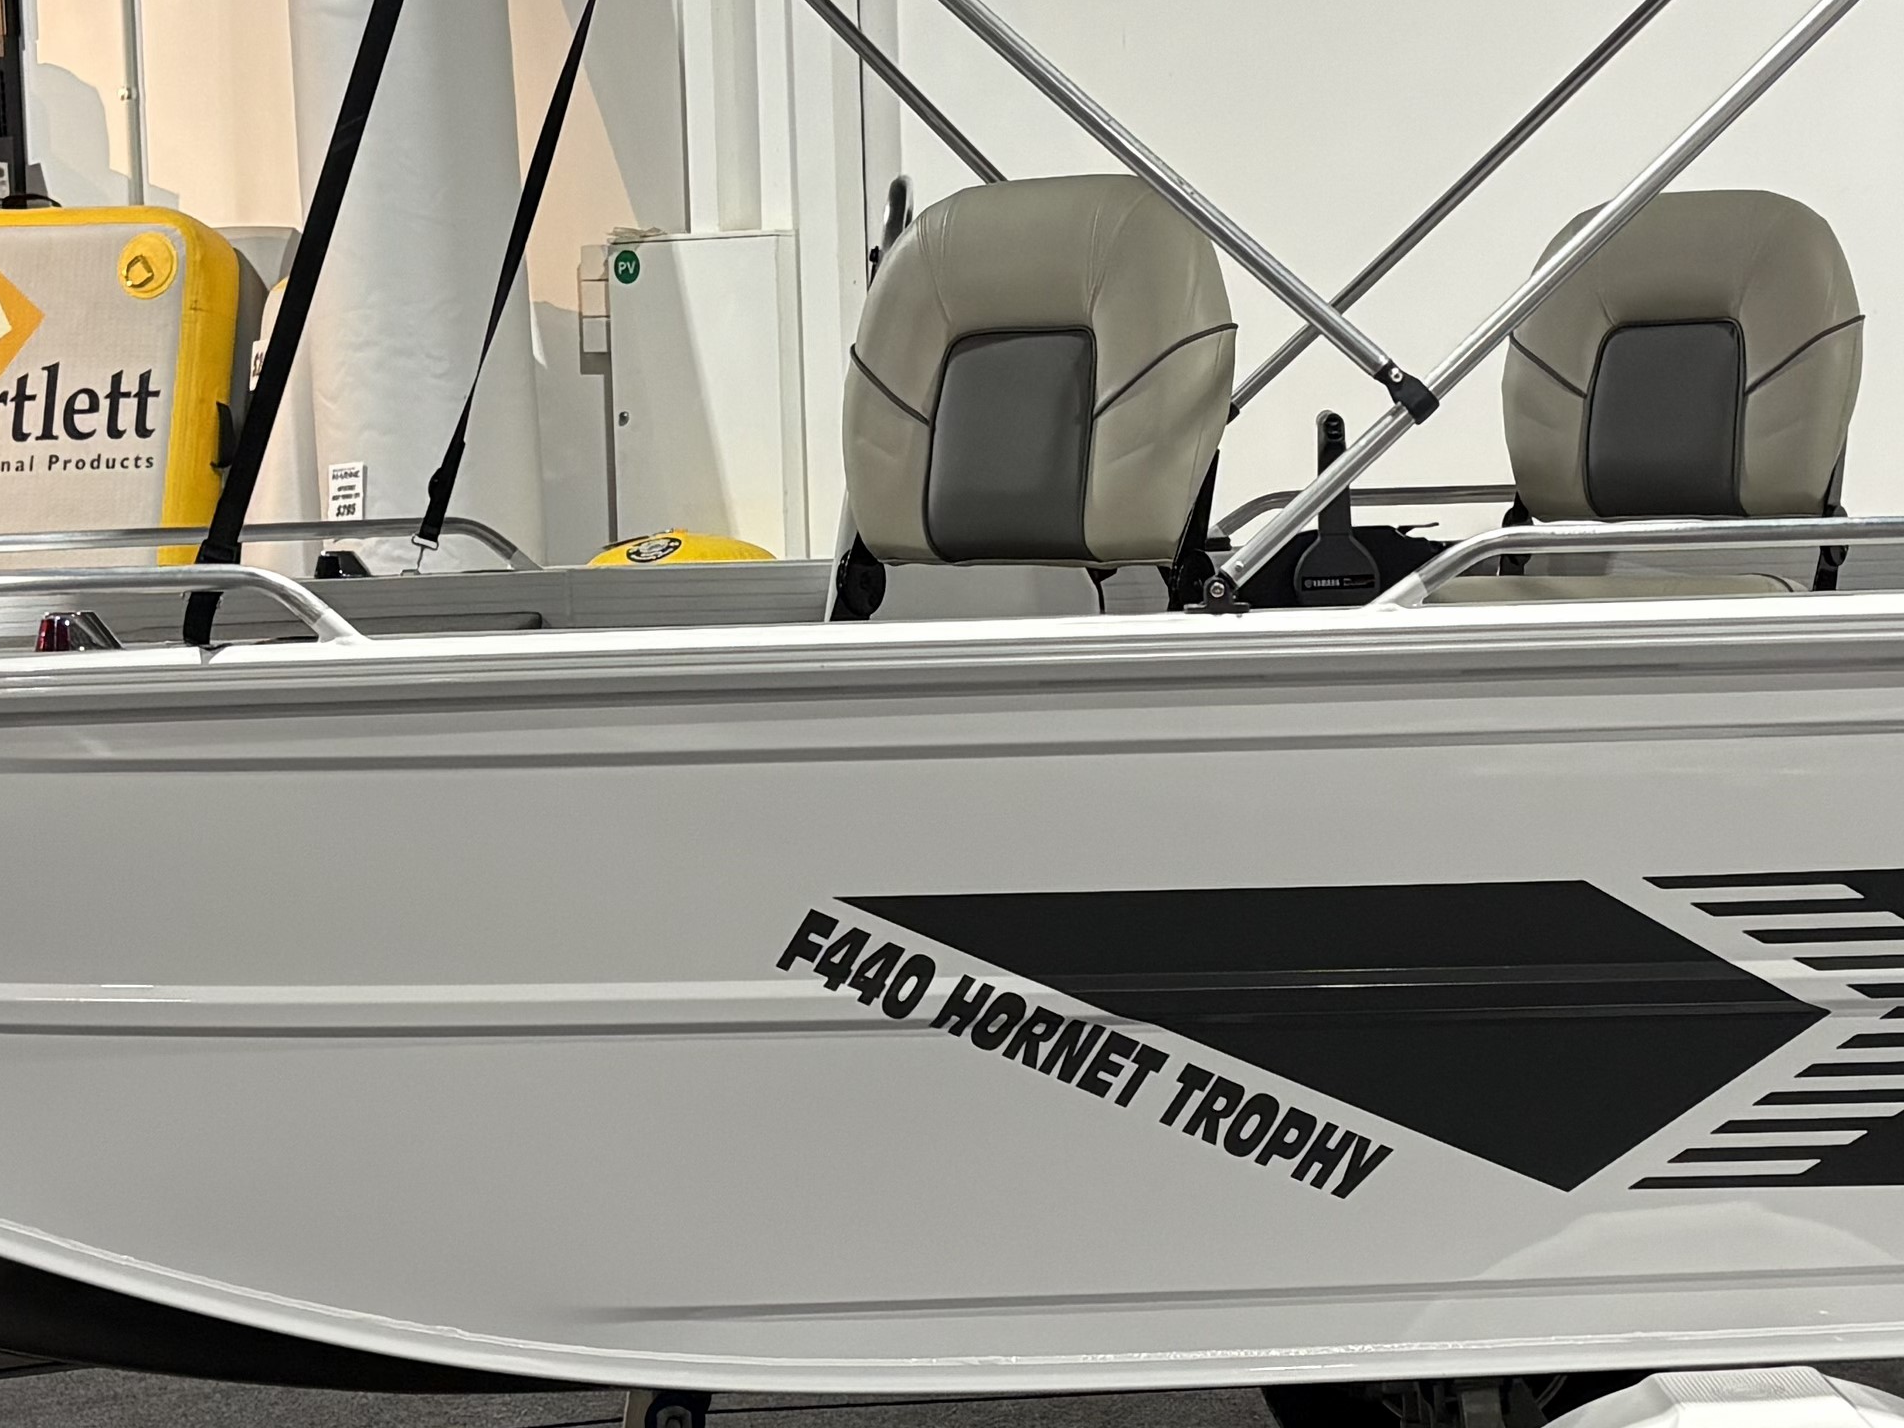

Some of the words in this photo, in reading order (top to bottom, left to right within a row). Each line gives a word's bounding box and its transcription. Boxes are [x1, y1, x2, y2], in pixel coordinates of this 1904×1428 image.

[618, 261, 636, 275] PV
[47, 452, 156, 473] Products
[1312, 578, 1341, 589] YAMAHA
[775, 907, 937, 1020] F440
[928, 972, 1171, 1109] HORNET
[1158, 1062, 1394, 1200] TROPHY
